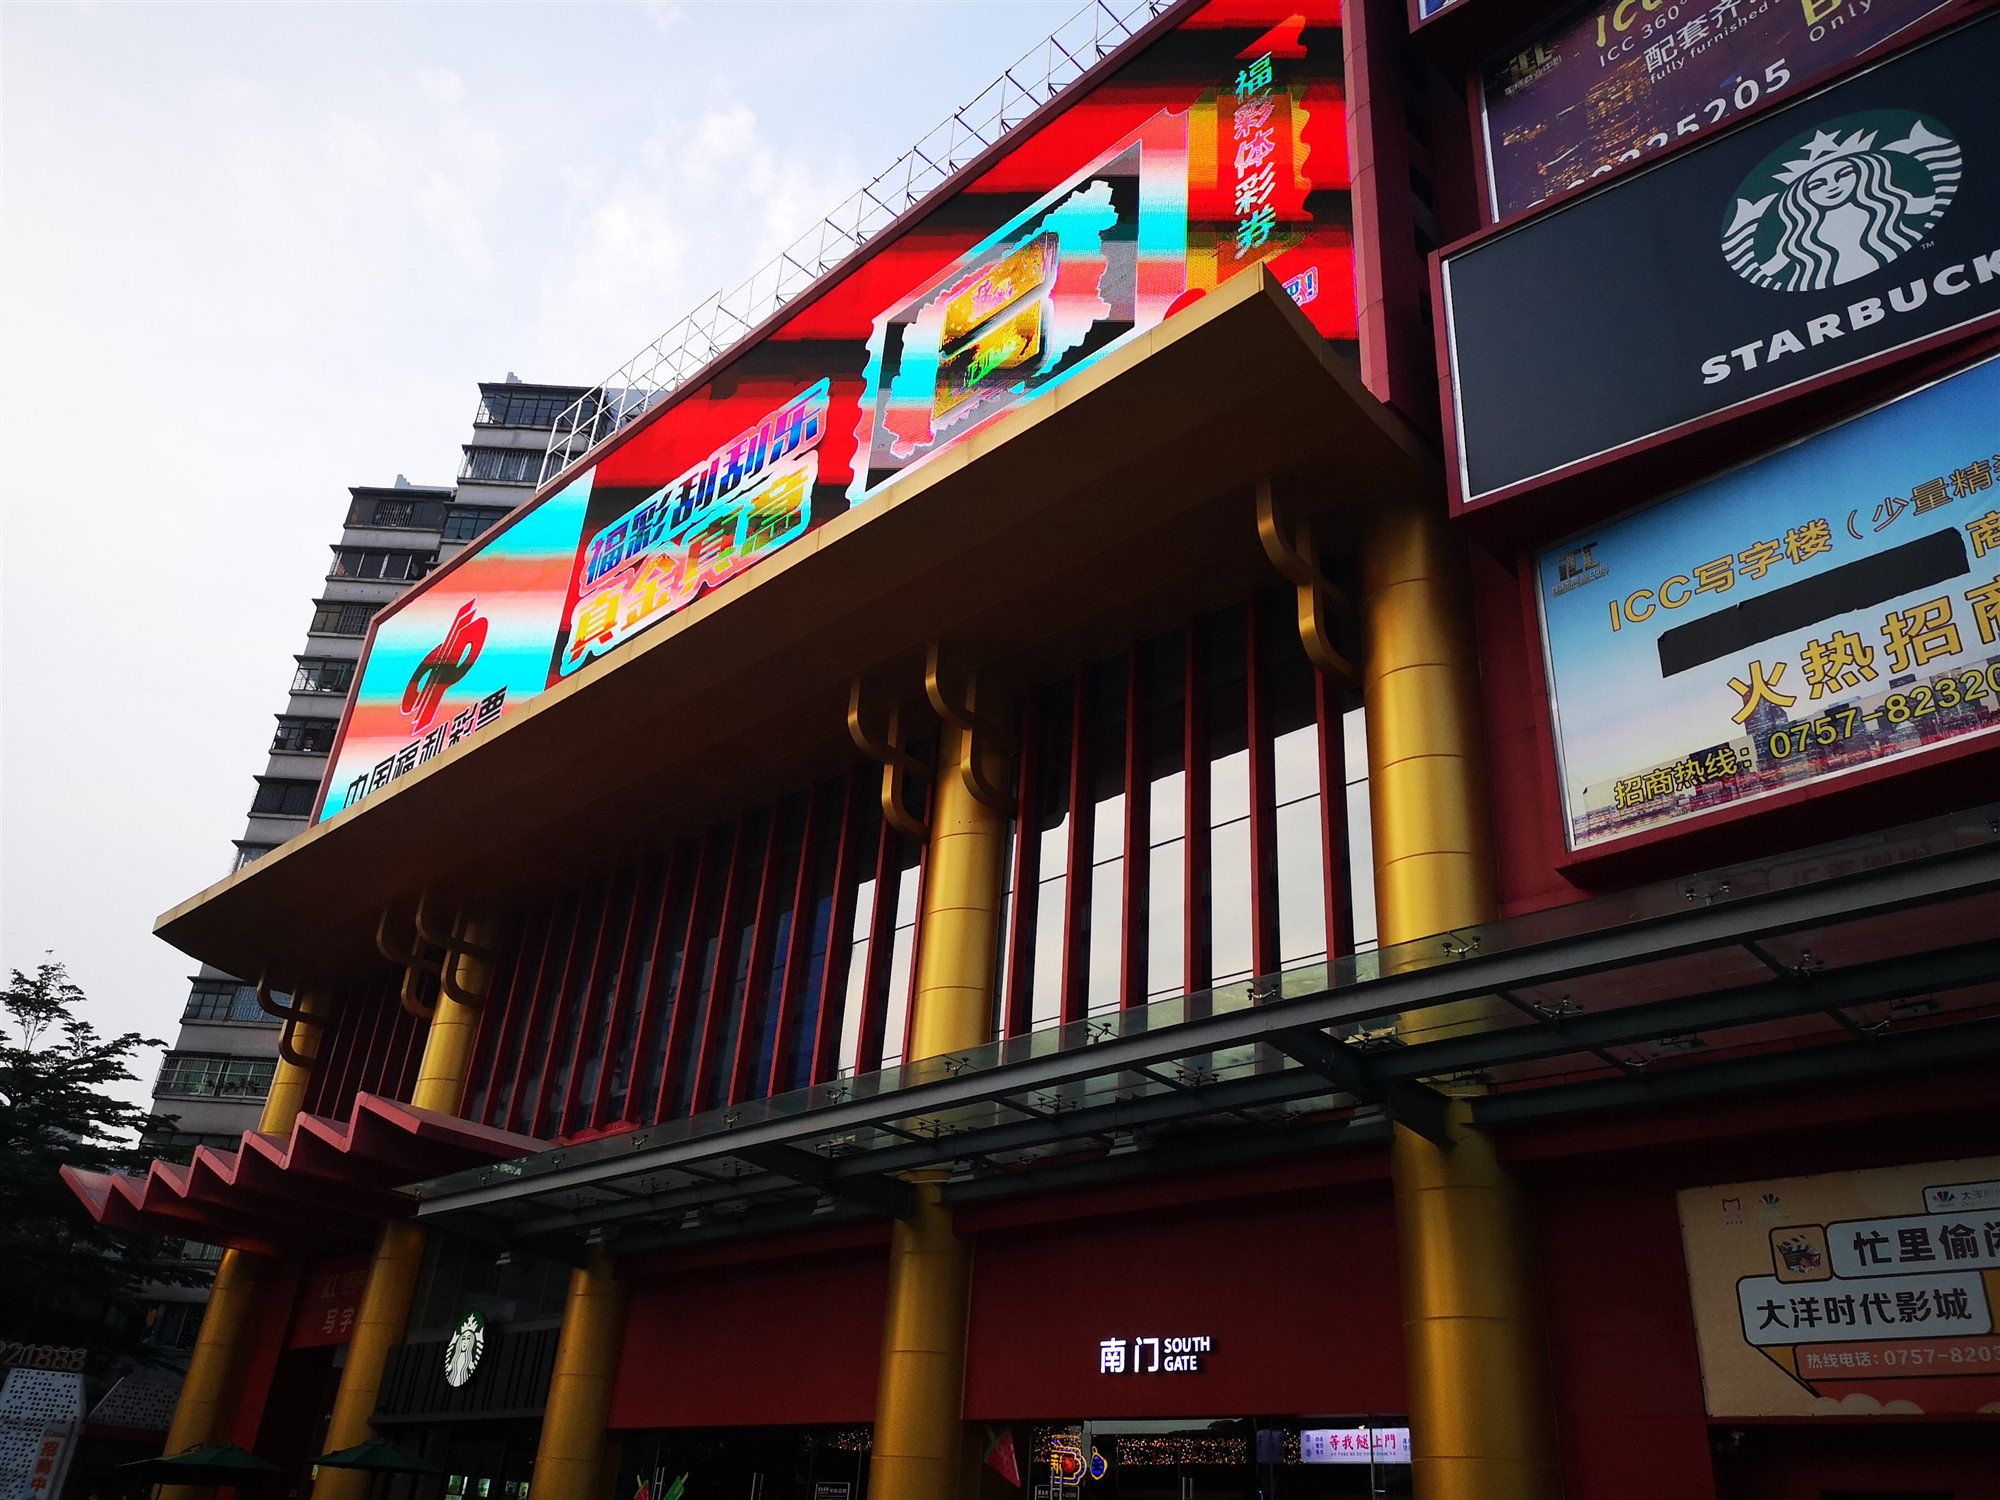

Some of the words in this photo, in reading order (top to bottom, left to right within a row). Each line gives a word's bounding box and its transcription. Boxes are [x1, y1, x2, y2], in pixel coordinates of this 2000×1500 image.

[1809, 0, 1872, 42] Only
[1600, 36, 1635, 67] ICC
[1650, 56, 1686, 84] fully
[1690, 3, 1769, 58] furnished
[586, 387, 824, 586] 福彩刮刮乐
[1756, 1288, 1972, 1330] 大洋时代影城
[1100, 1337, 1159, 1373] 南门
[1163, 1336, 1211, 1353] SOUTH
[1163, 1355, 1198, 1372] GATE
